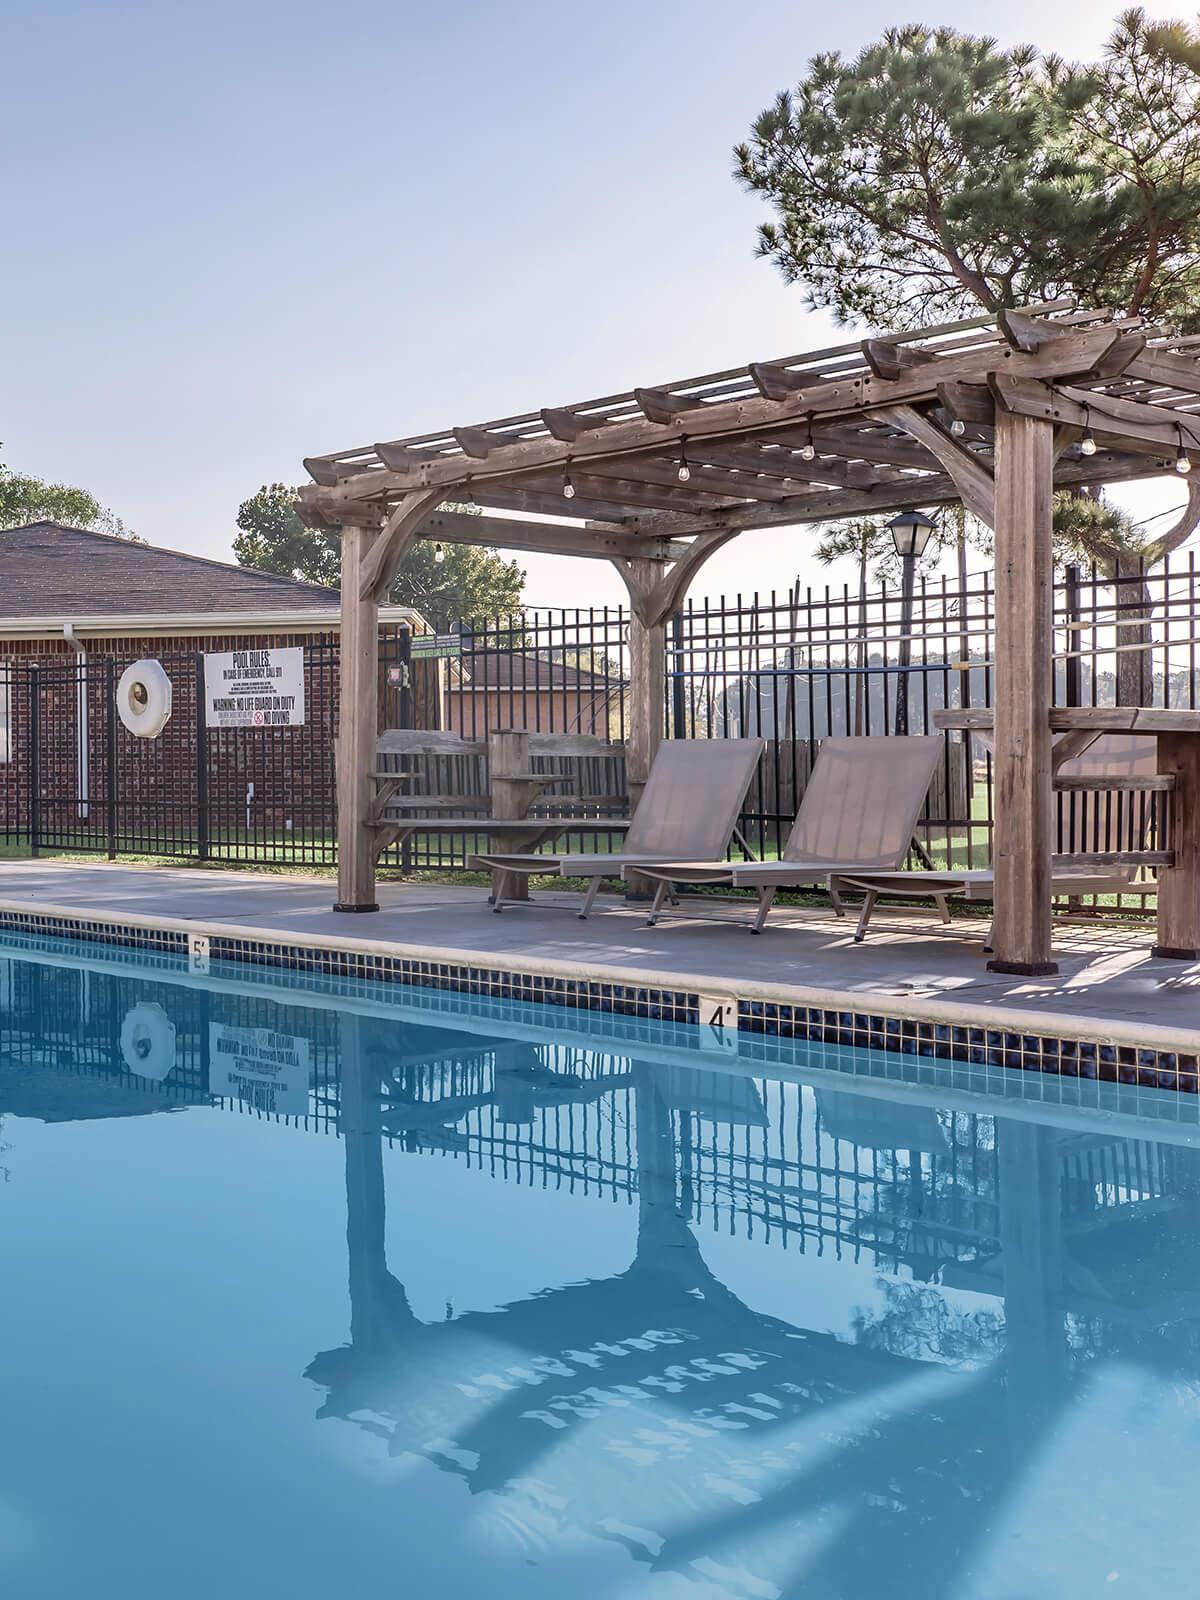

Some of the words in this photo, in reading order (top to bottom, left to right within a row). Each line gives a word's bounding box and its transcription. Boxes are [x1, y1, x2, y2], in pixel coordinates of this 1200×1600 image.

[233, 652, 248, 668] POOL
[250, 650, 270, 668] RULES:
[237, 698, 244, 711] NO
[244, 697, 254, 711] LIFE
[254, 697, 272, 711] GUARD
[273, 697, 280, 710] ON
[281, 696, 295, 710] DUTY
[264, 711, 271, 724] NO
[272, 711, 289, 724] DIVING
